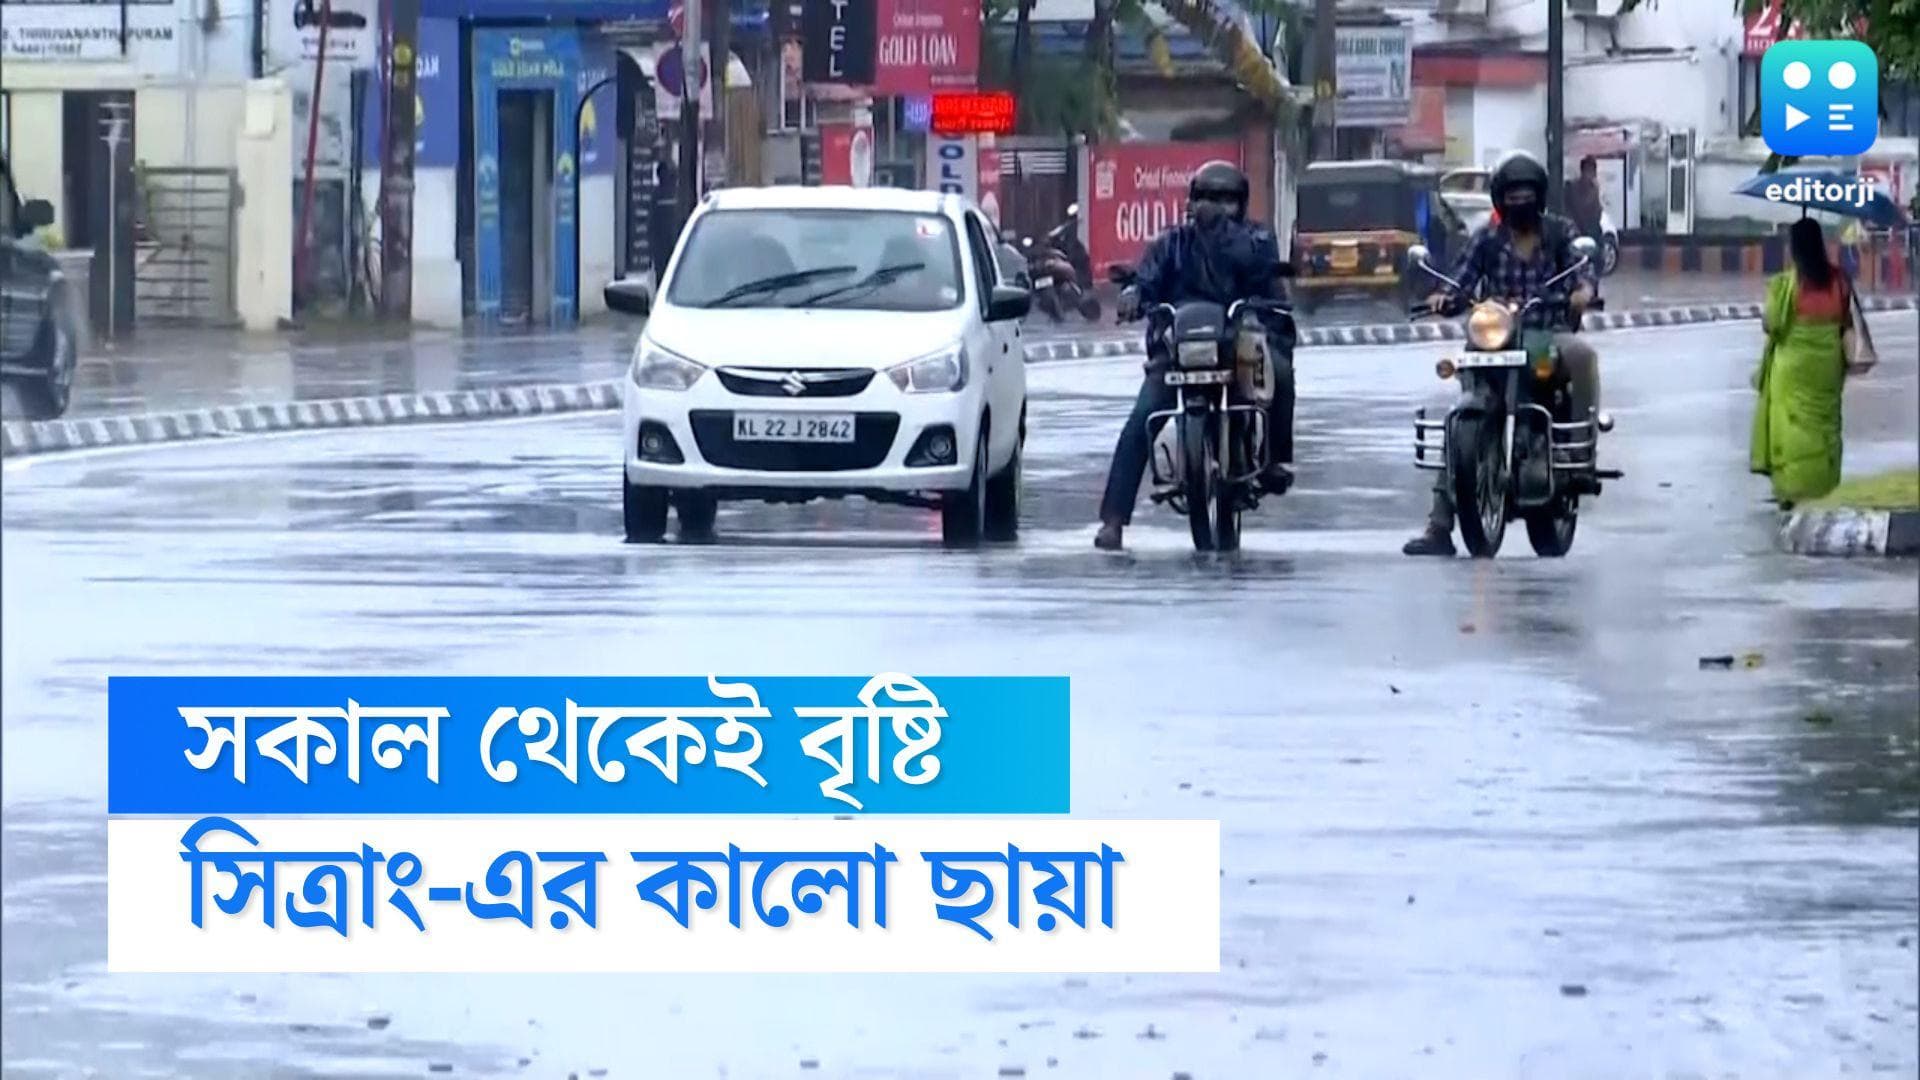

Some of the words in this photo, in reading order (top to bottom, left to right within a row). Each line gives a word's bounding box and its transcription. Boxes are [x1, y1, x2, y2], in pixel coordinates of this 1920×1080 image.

[878, 35, 918, 66] GOLD
[921, 32, 958, 67] LOAN
[1116, 200, 1167, 242] GOLD
[737, 418, 758, 437] KL
[764, 418, 786, 437] 22
[791, 418, 802, 437] J
